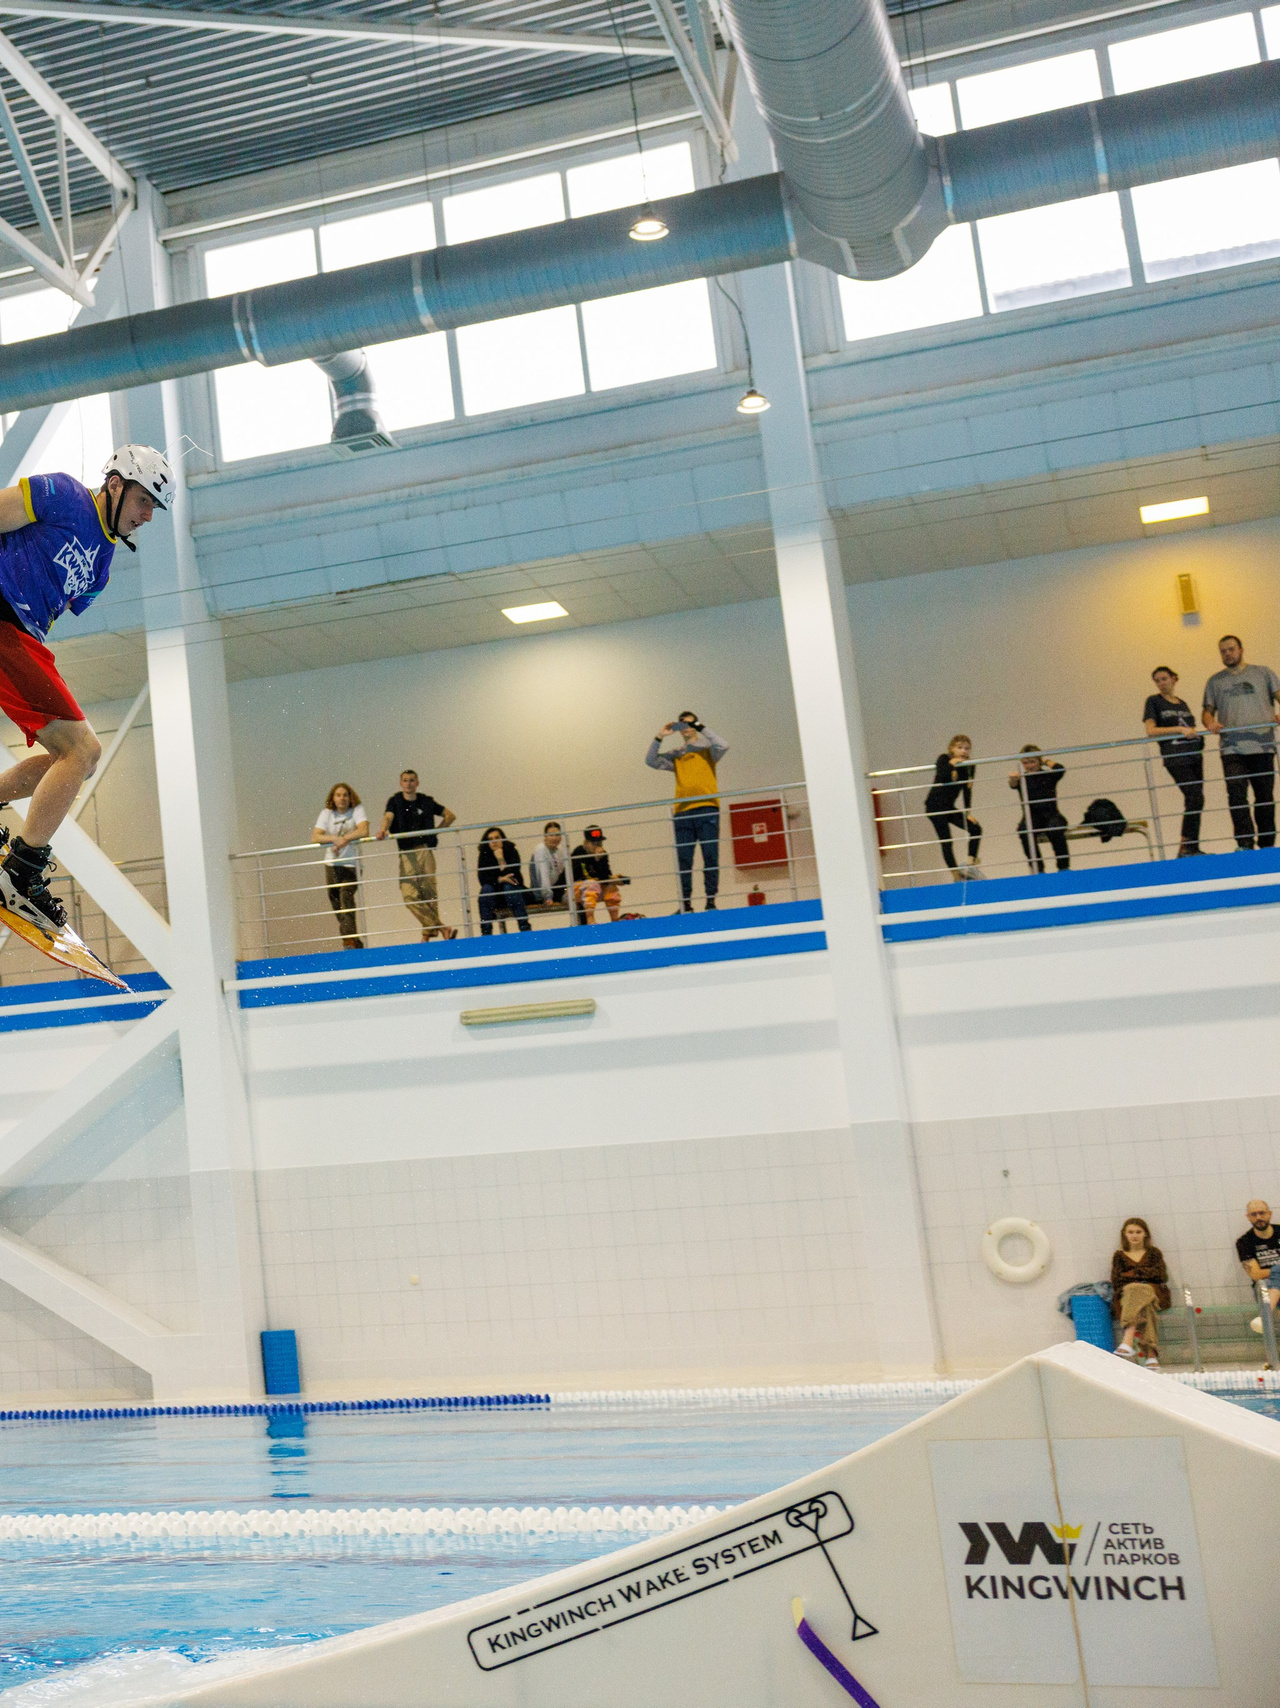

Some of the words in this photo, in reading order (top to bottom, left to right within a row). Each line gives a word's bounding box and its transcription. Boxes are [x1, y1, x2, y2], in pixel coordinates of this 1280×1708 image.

[1108, 1522, 1154, 1535] СЕТЬ
[1103, 1538, 1165, 1550] АКТИВ
[1103, 1553, 1180, 1566] ПАРКОВ
[487, 1594, 617, 1654] KINGWINCH
[618, 1567, 689, 1604] WAKE
[691, 1529, 784, 1576] SYSTEM
[964, 1575, 1187, 1601] KINGWINCH
